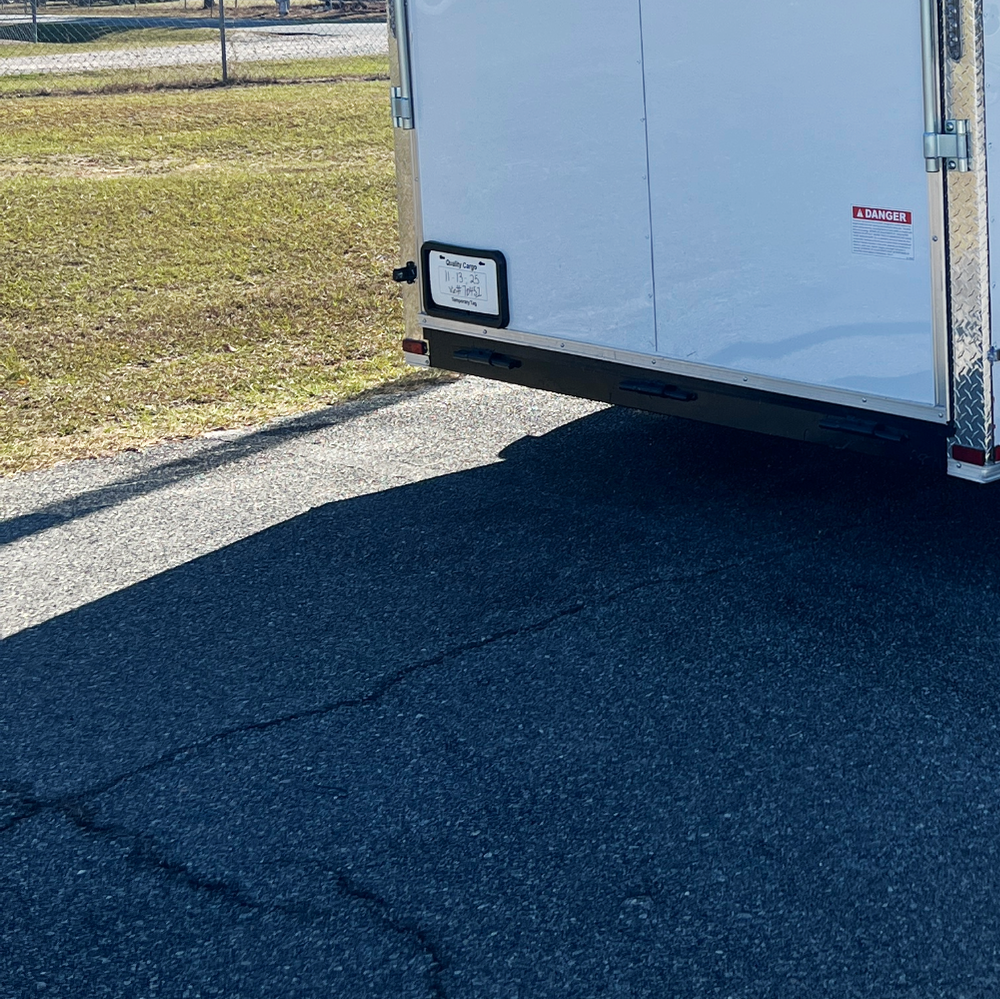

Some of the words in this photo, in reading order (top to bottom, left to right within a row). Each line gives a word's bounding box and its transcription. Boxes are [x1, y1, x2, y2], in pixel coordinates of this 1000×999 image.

[865, 208, 907, 222] DANGER
[446, 259, 462, 269] Quality
[462, 262, 478, 271] Cargo
